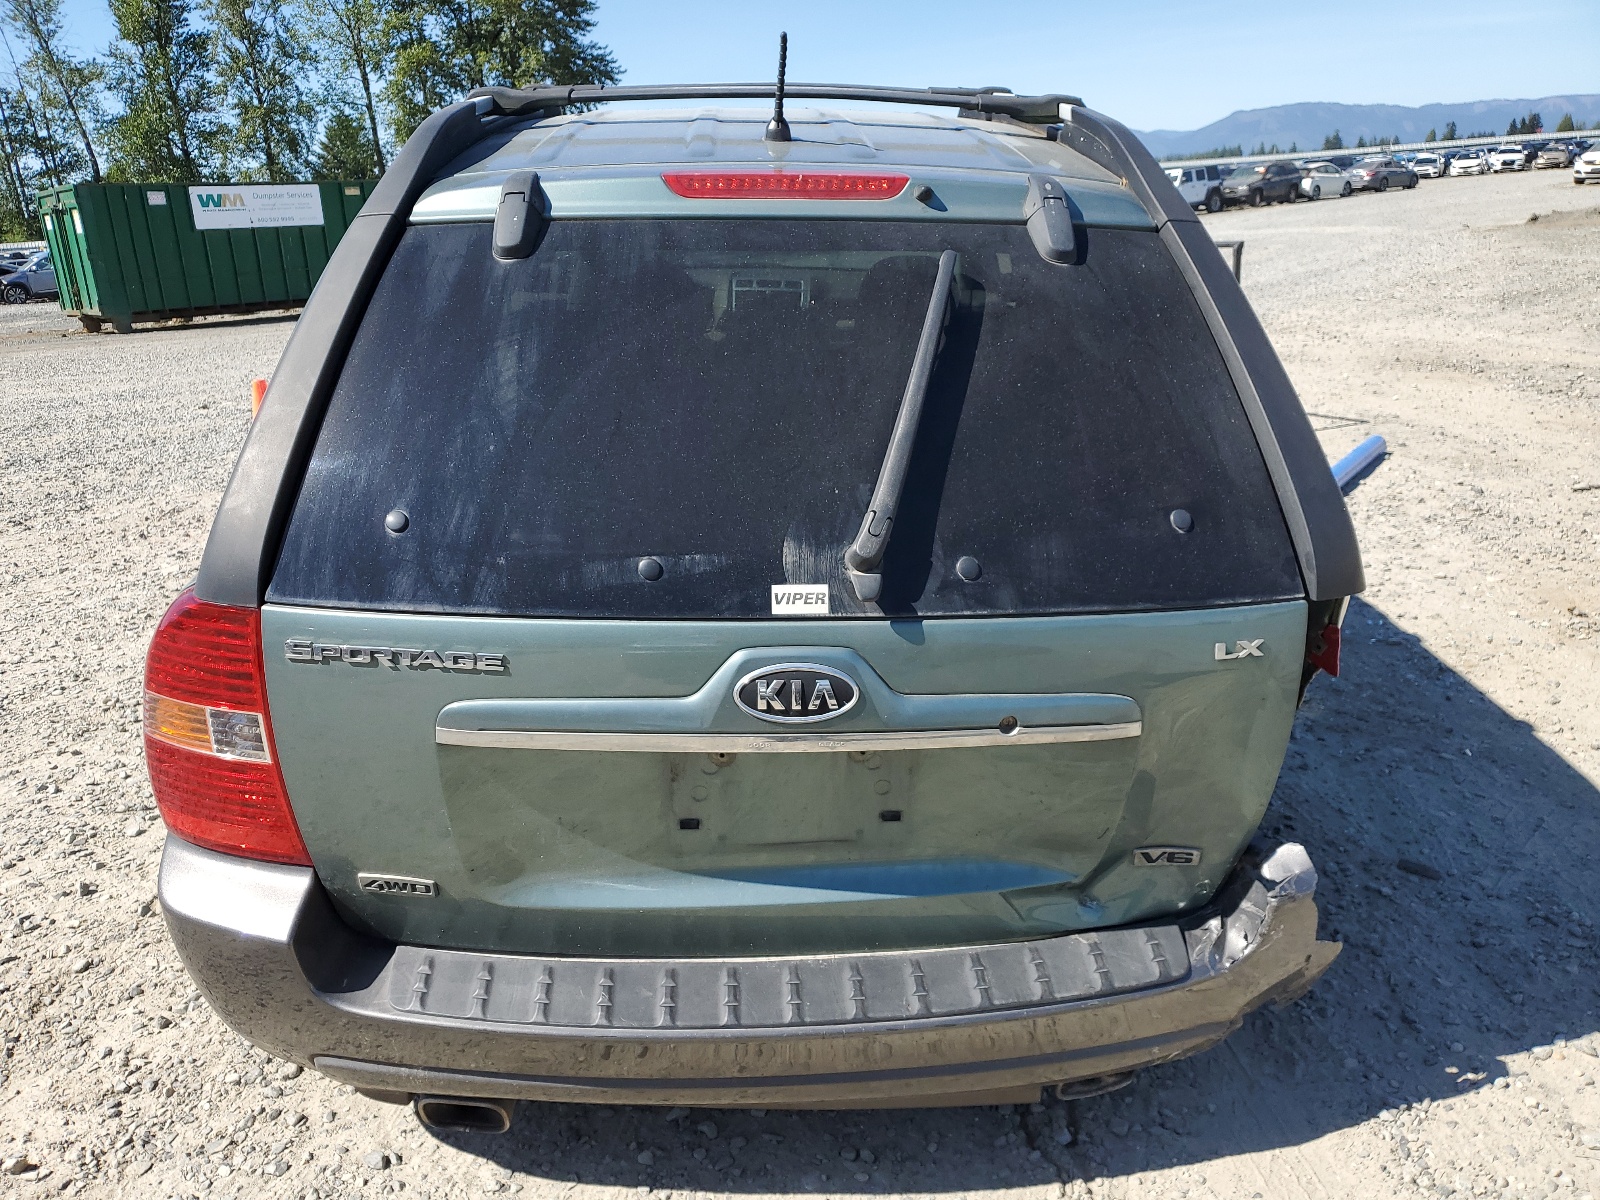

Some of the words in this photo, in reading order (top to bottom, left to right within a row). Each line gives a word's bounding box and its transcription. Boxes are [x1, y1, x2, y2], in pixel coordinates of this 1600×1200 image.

[197, 193, 246, 208] WM
[252, 192, 285, 200] Dumpster
[286, 191, 313, 199] Services
[774, 592, 828, 605] VIPER
[284, 638, 506, 672] SPORTAGE
[1214, 638, 1265, 660] LX
[755, 679, 839, 711] KIA
[1140, 851, 1194, 864] V6
[363, 879, 433, 895] 4WD
